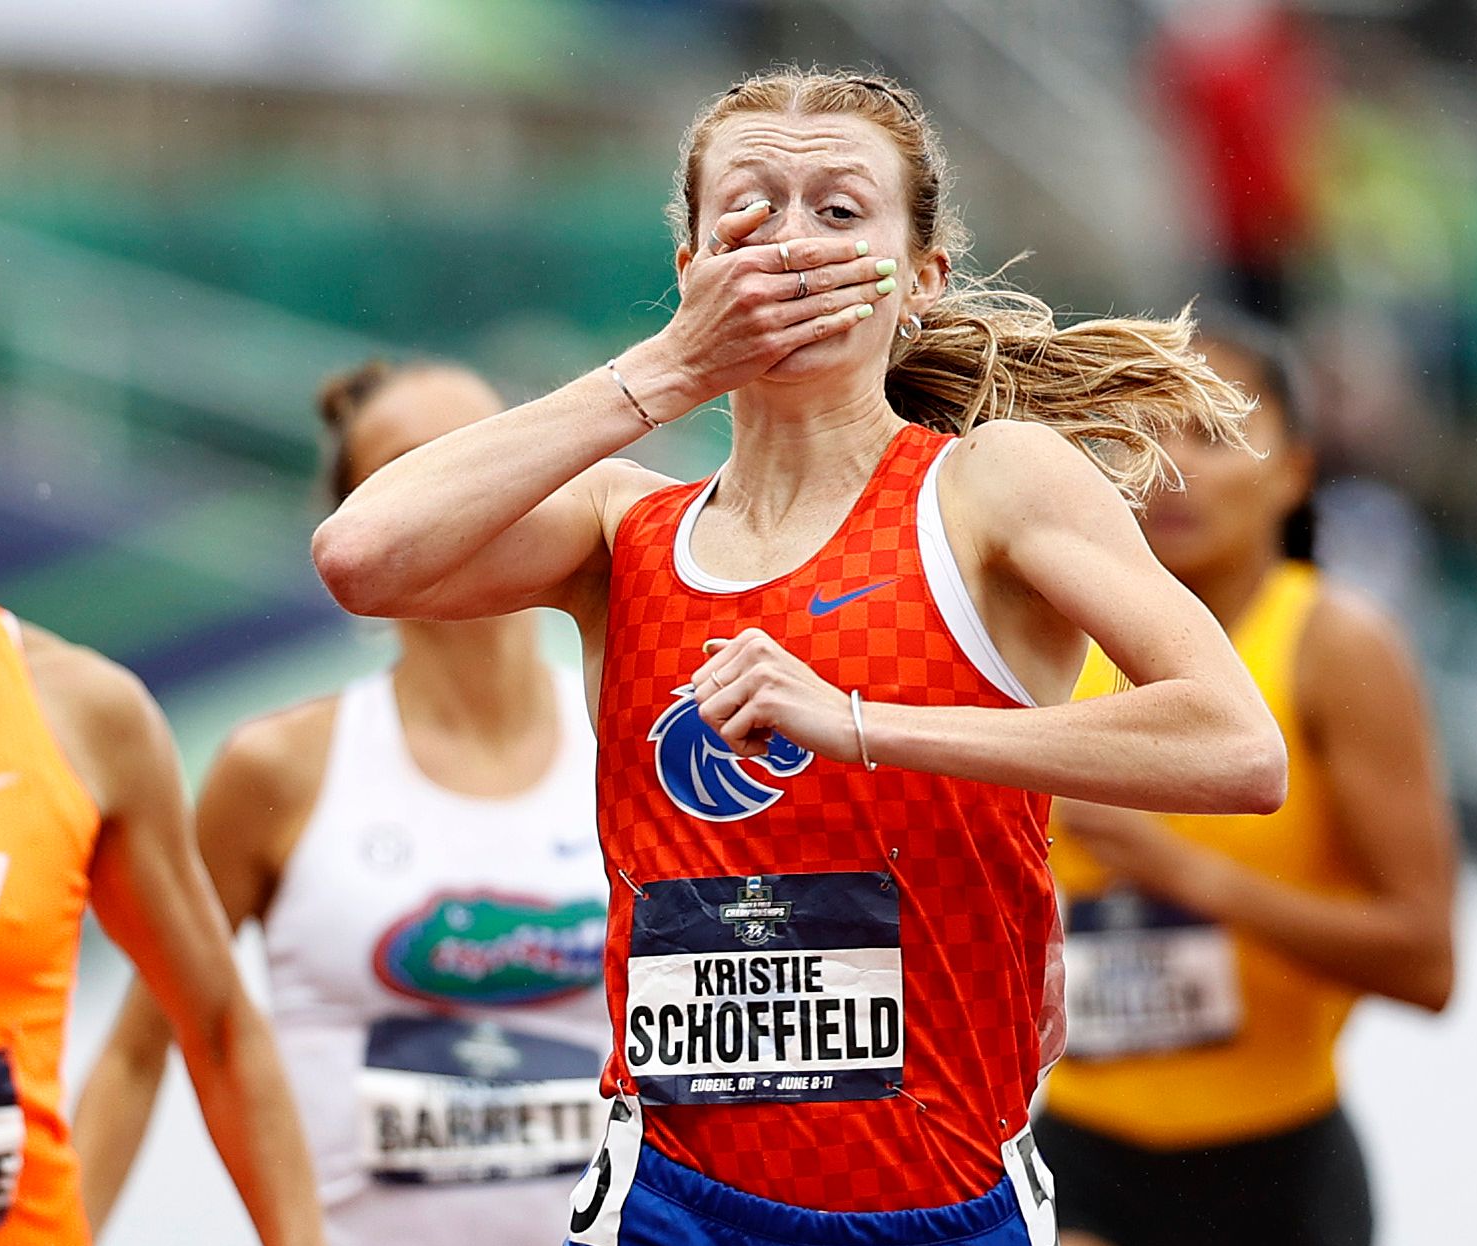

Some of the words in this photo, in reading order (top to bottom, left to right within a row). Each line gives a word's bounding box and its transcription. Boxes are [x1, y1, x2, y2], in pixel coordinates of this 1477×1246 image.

[694, 955, 824, 997] KRISTIE
[627, 996, 901, 1067] SCHOFFIELD
[690, 1078, 736, 1092] EUGENE,
[738, 1077, 756, 1091] OR
[776, 1076, 809, 1090] JUNE
[810, 1076, 833, 1090] 8-11
[374, 1102, 594, 1152] BARRETT
